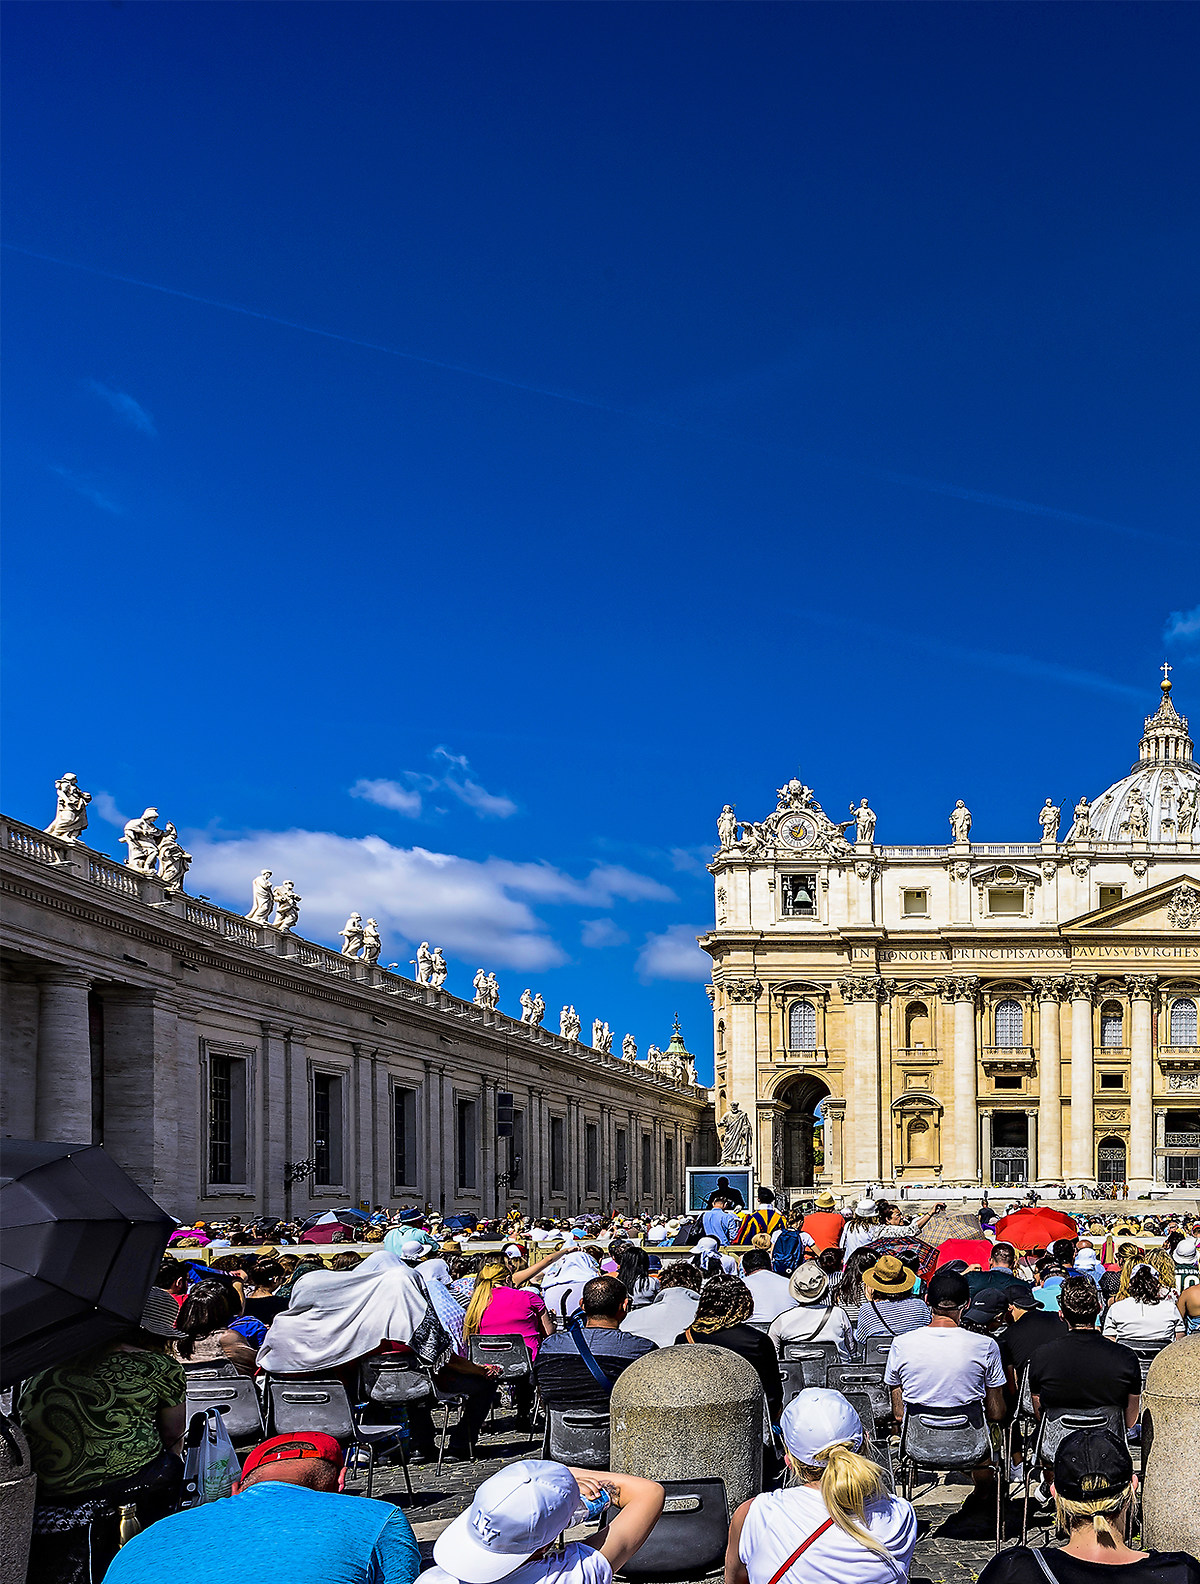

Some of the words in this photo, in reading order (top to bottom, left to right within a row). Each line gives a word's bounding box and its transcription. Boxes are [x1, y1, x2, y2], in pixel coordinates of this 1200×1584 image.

[853, 948, 870, 958] IN
[880, 950, 950, 961] HONOREM
[953, 948, 1025, 959] PRINCIPIS
[1073, 946, 1119, 957] PAVLVS
